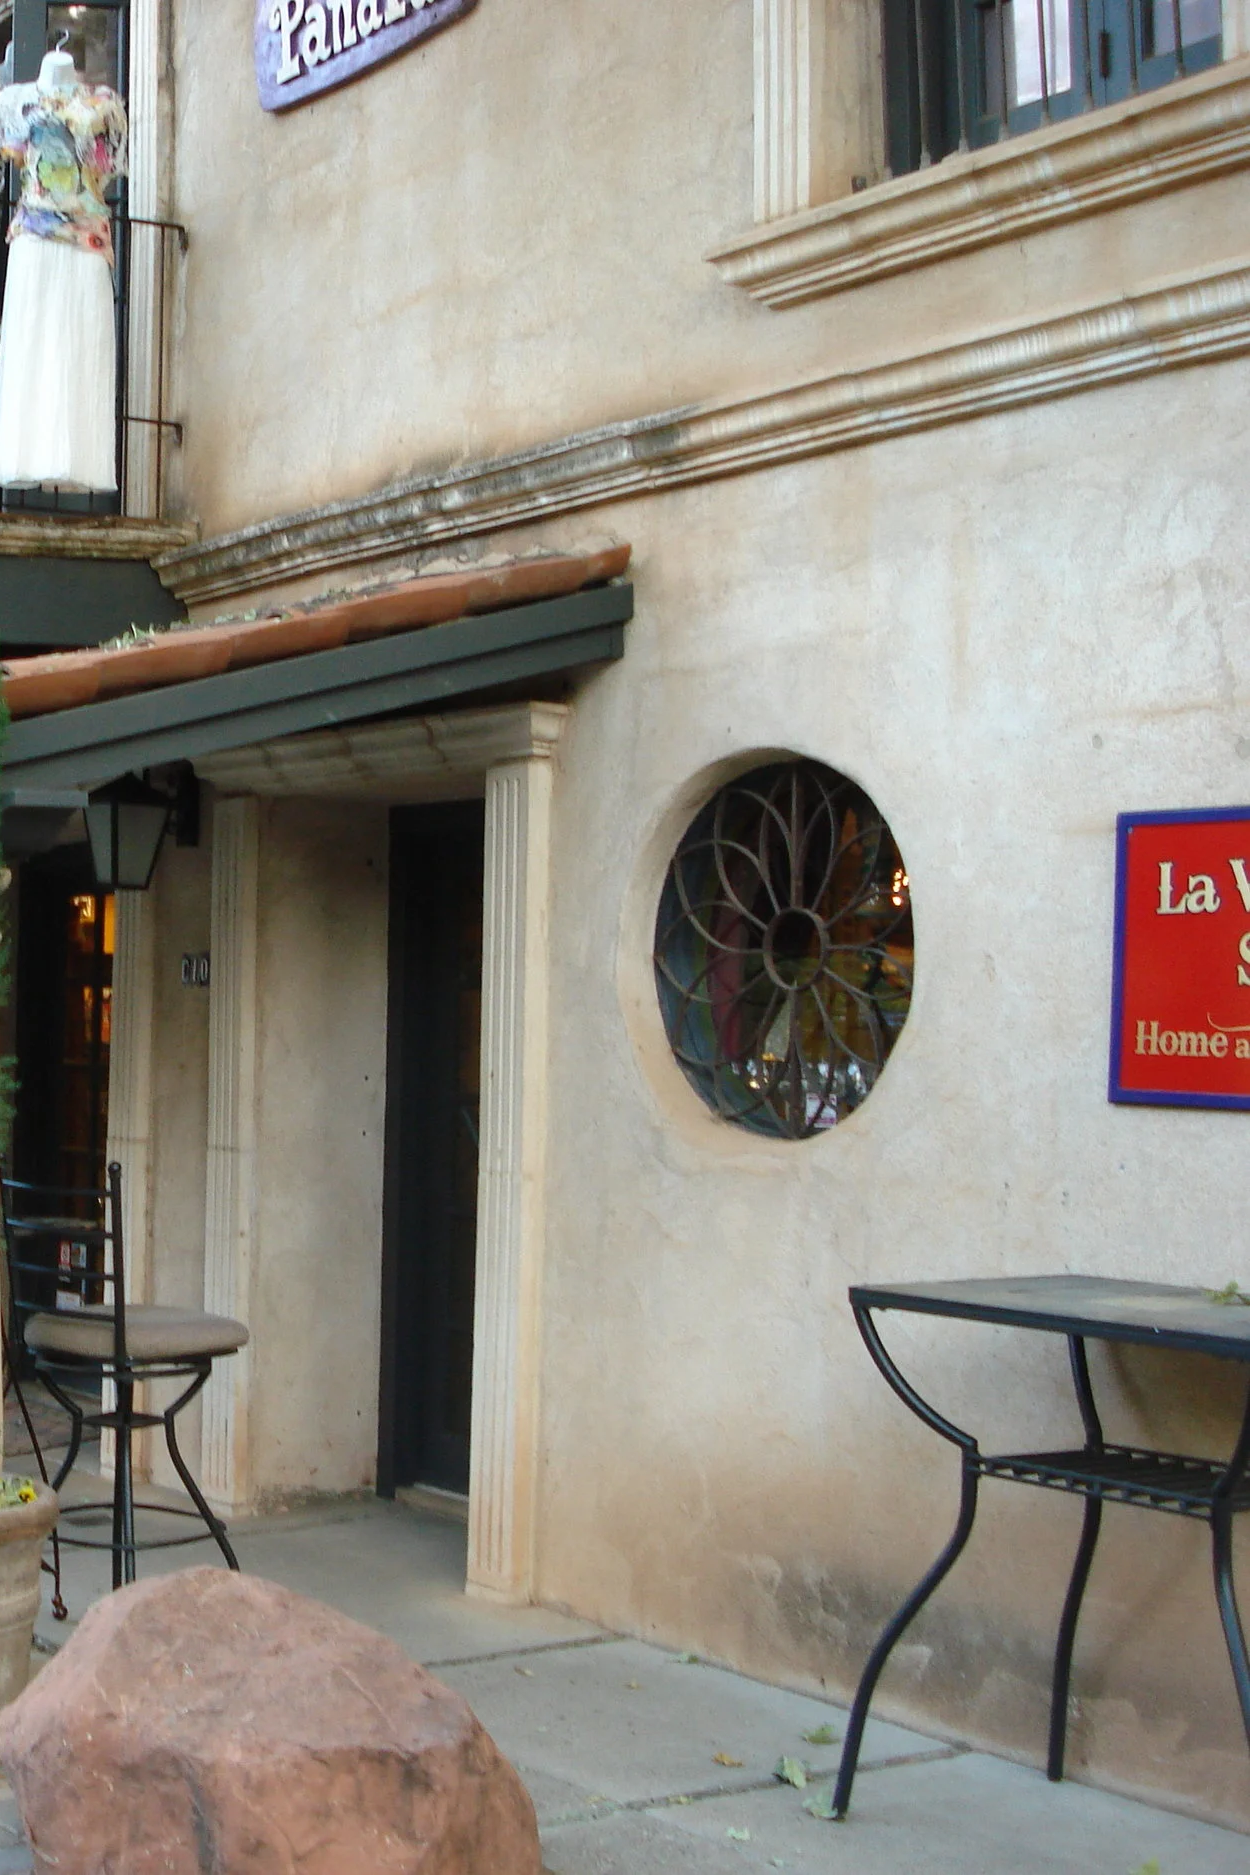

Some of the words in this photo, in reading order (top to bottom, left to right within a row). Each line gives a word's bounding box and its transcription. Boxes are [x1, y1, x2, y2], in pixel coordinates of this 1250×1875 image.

[268, 0, 436, 85] Pana
[1155, 861, 1221, 915] La
[1134, 1019, 1229, 1058] Home
